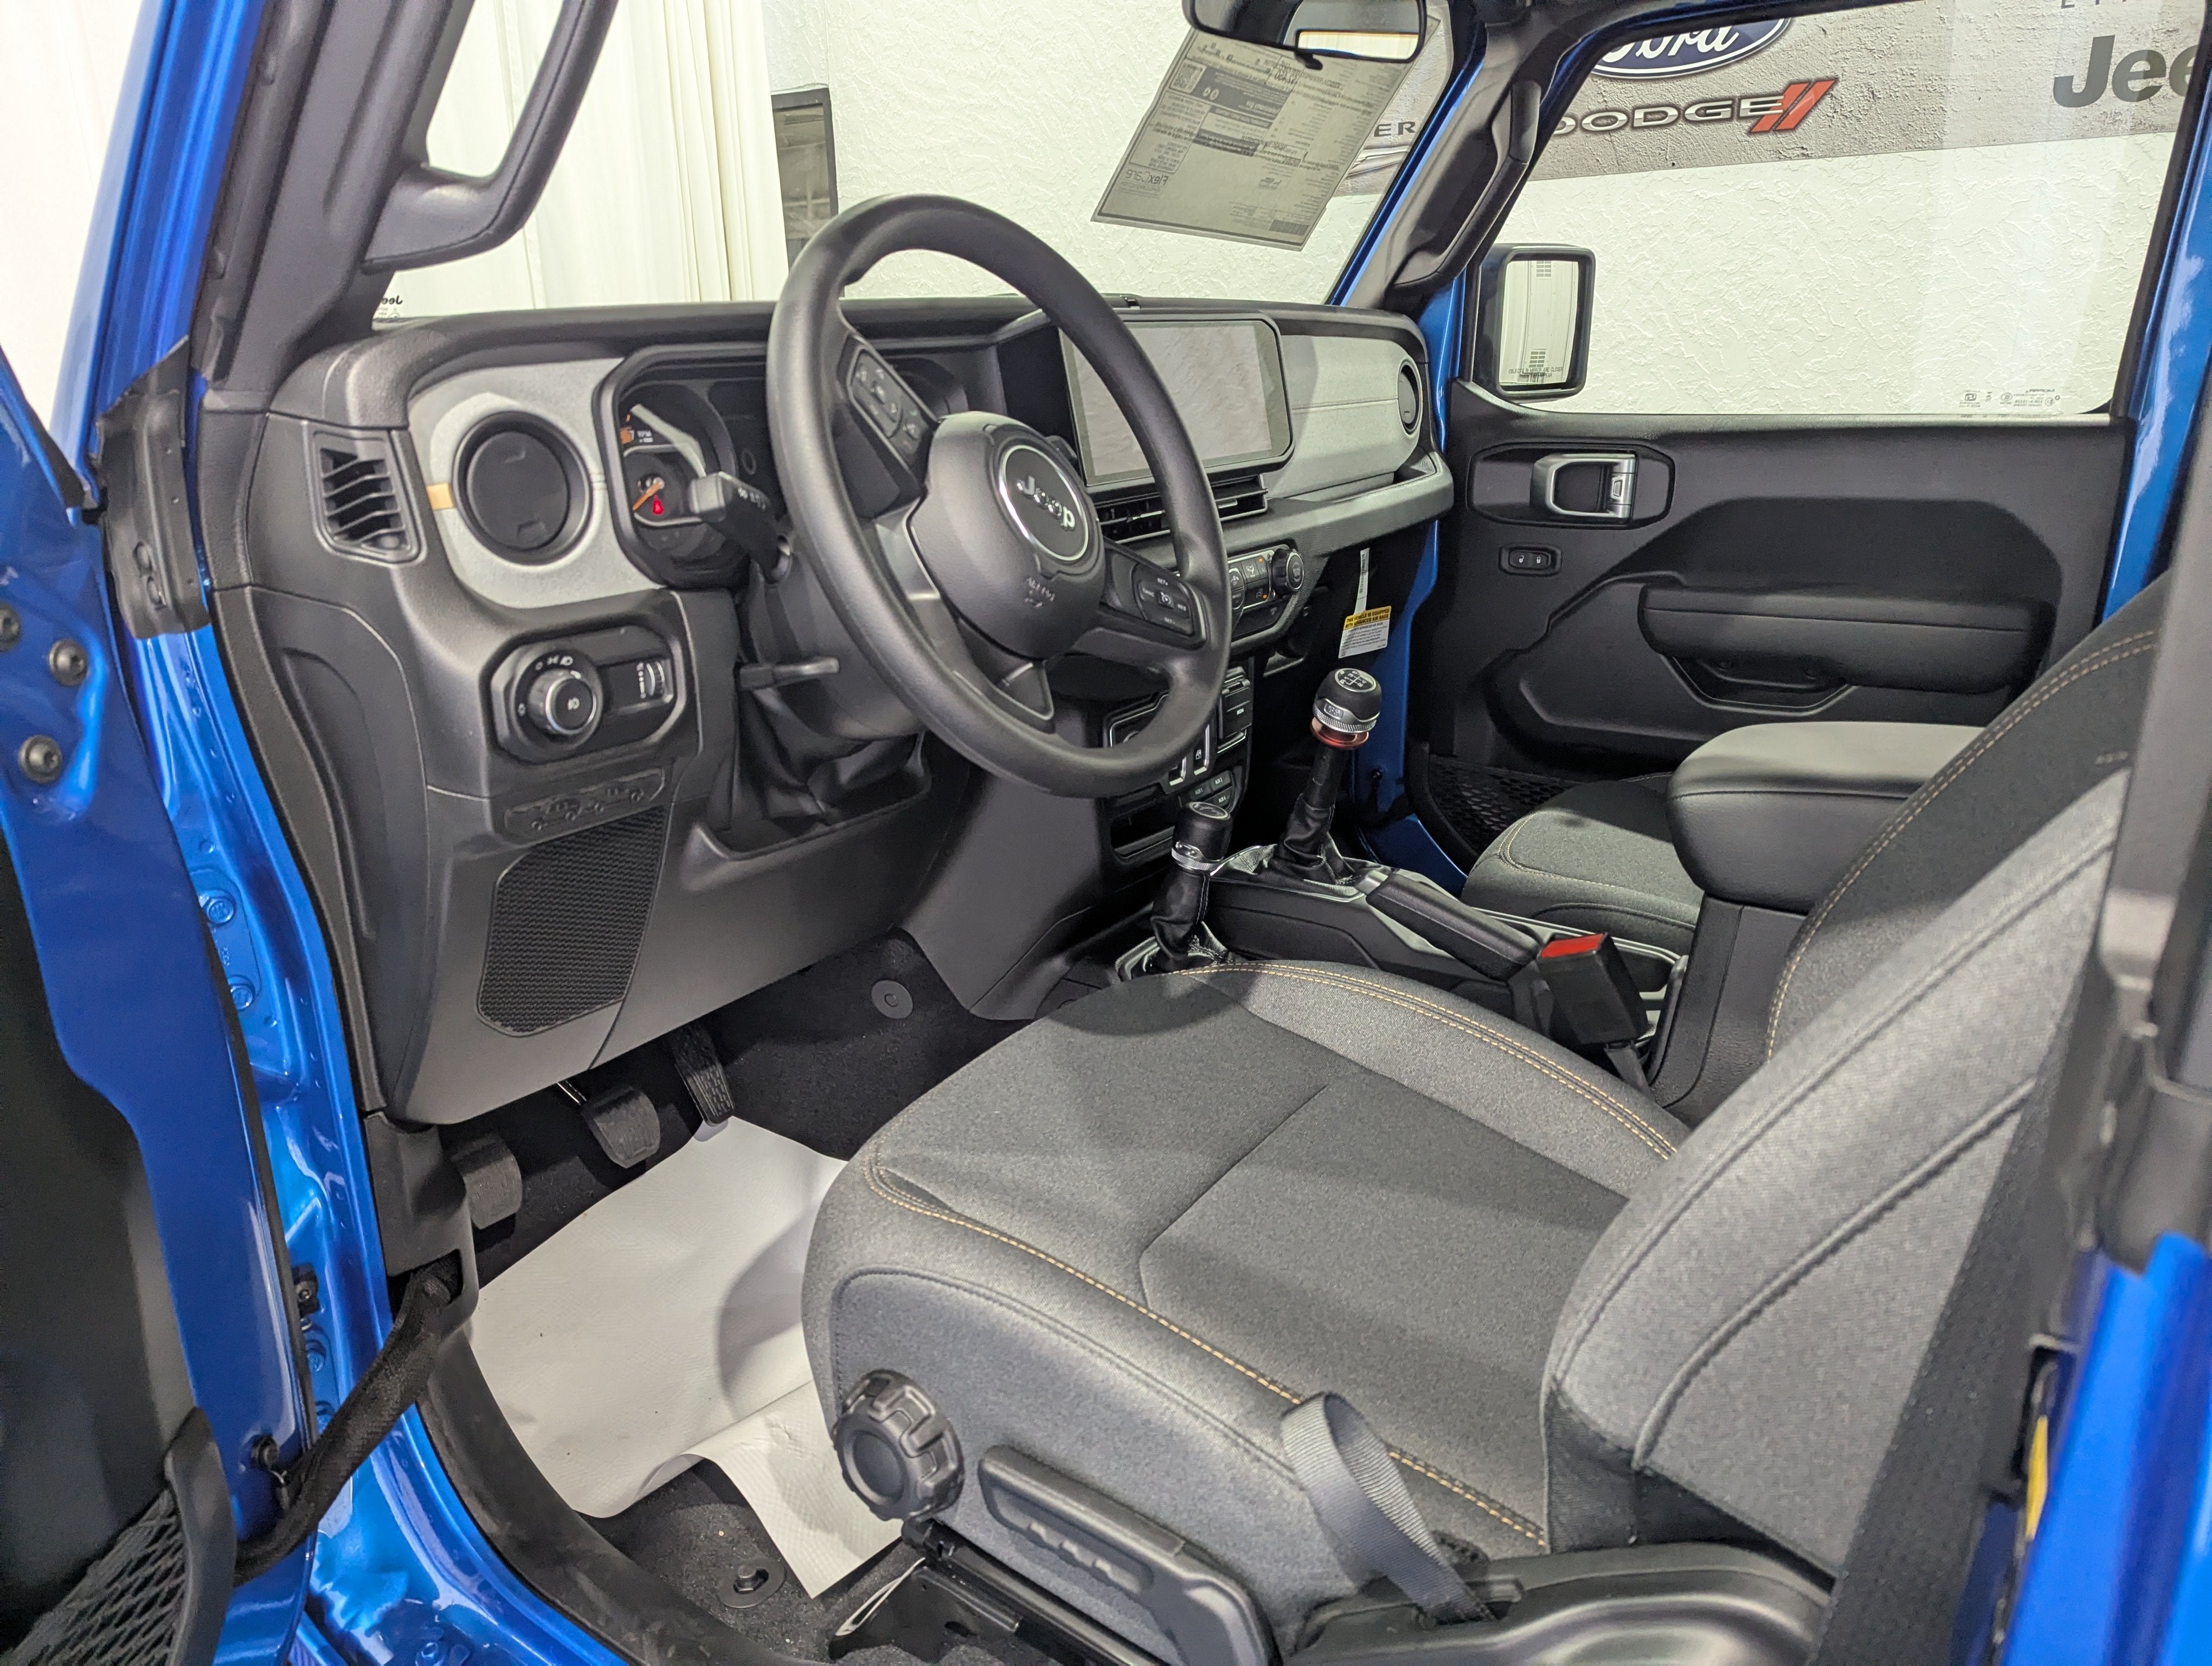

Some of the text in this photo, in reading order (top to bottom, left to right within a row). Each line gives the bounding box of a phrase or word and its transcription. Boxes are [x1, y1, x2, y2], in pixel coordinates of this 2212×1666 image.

[1602, 25, 1739, 63] ord
[1017, 476, 1076, 528] Jeep
[1353, 617, 1372, 626] ADVANCED
[1372, 608, 1390, 617] EQUIPPED
